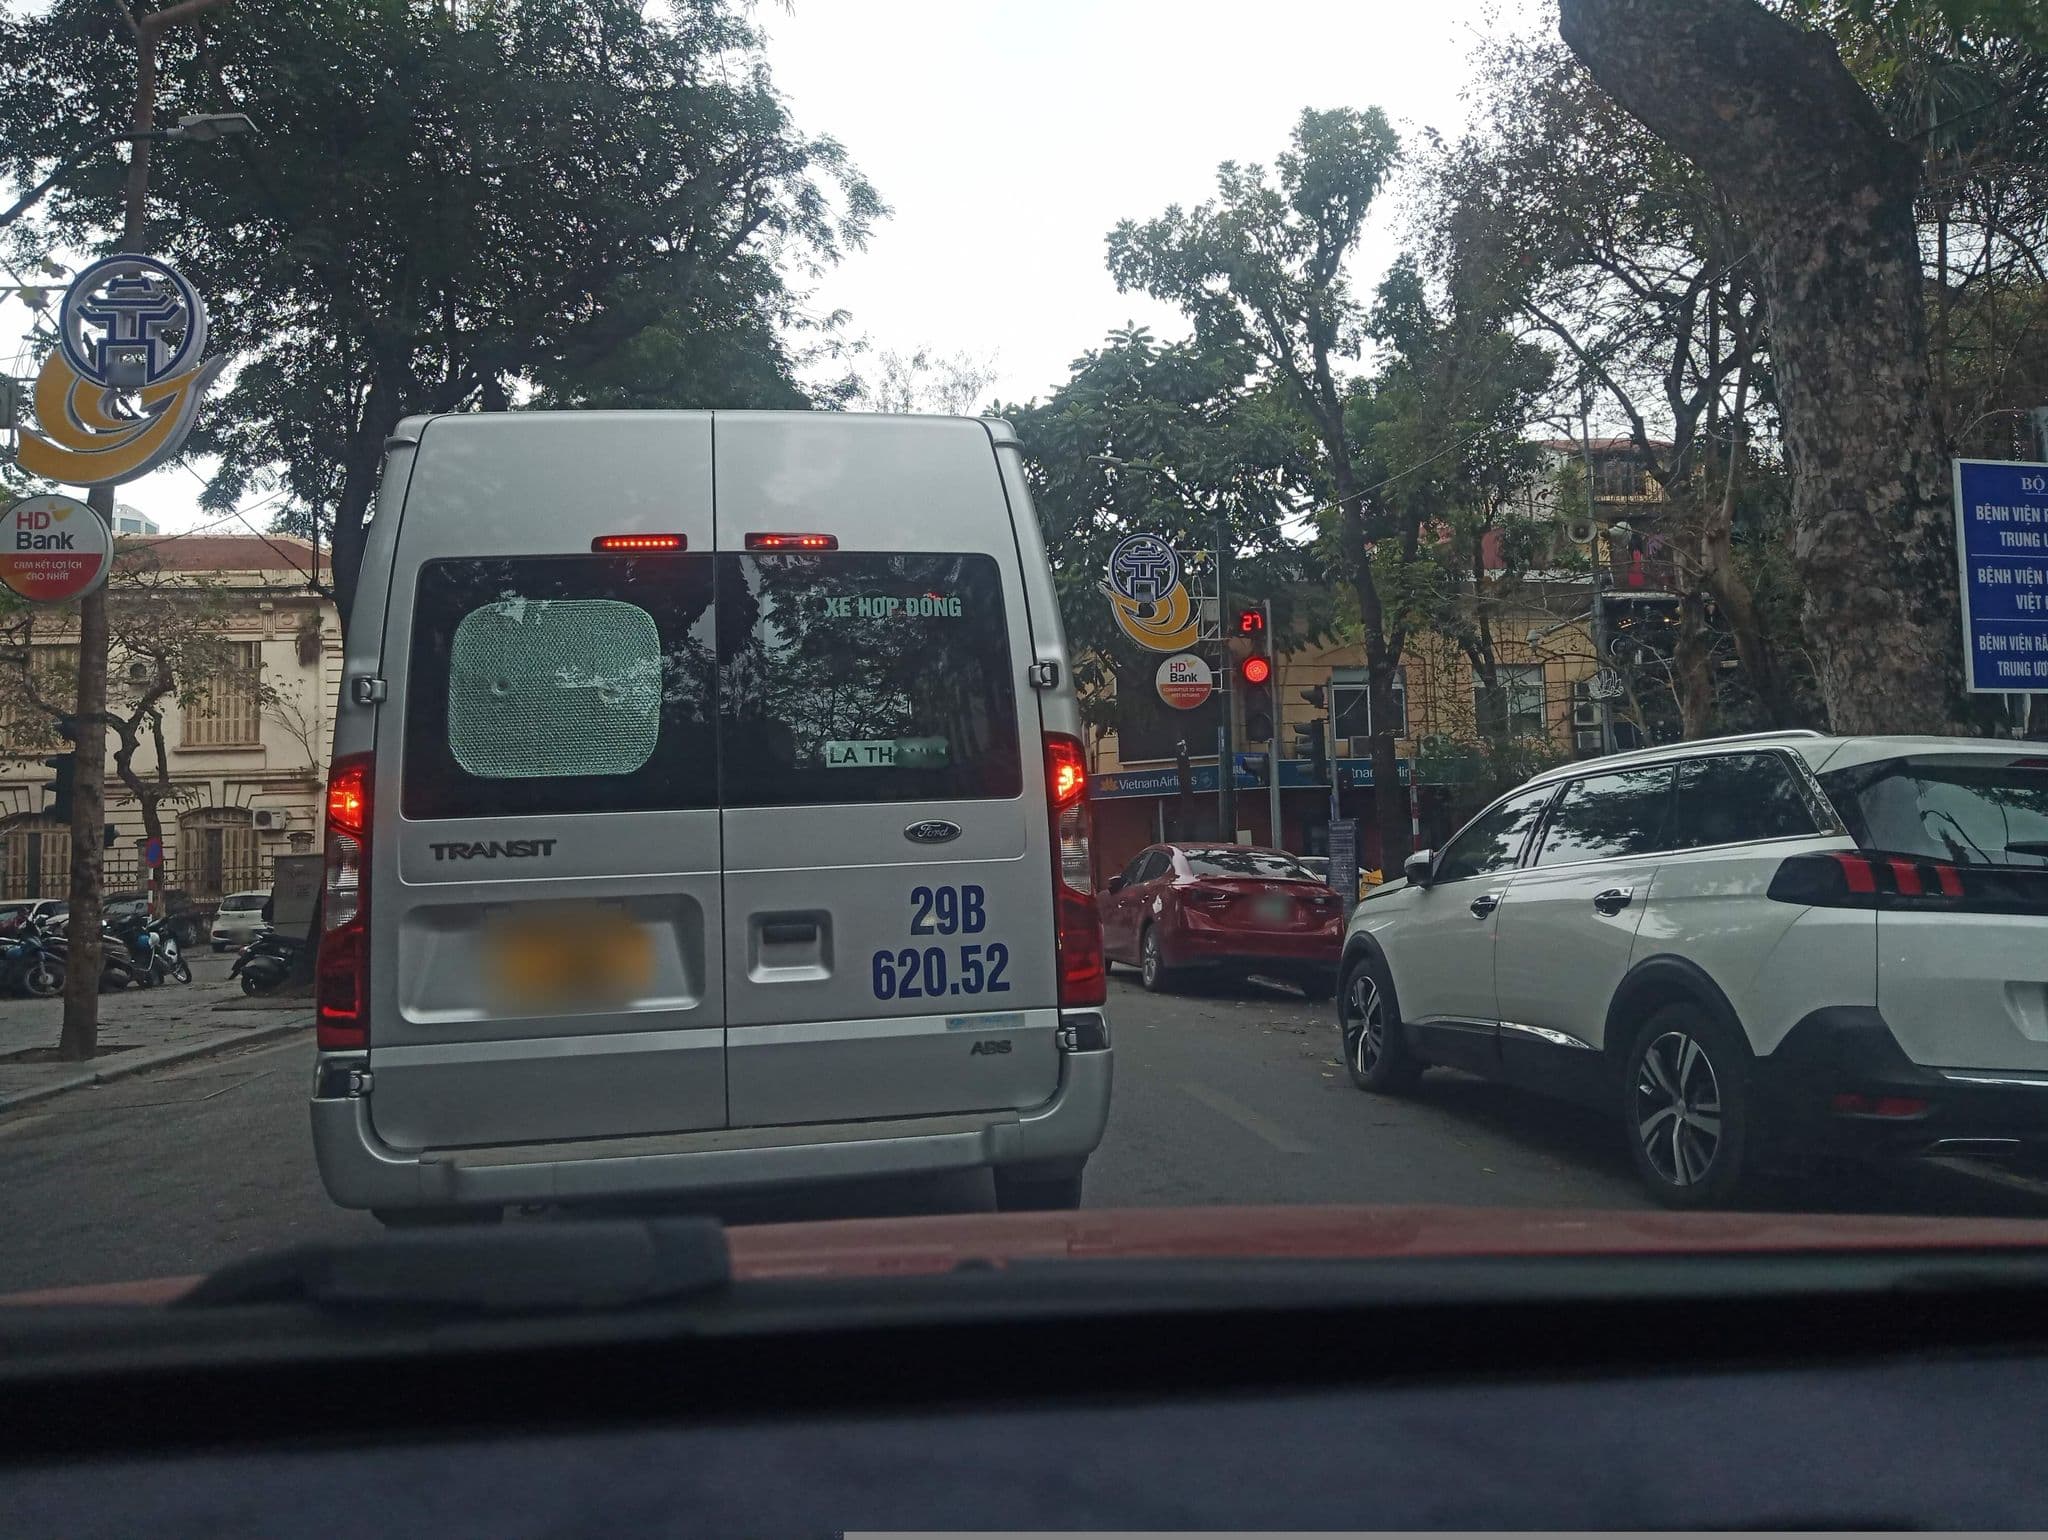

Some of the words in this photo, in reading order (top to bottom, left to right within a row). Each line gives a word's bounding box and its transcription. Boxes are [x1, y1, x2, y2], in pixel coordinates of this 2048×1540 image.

[2021, 474, 2046, 494] BỘ
[16, 511, 51, 530] HD
[1976, 503, 2009, 524] BỆNH
[2012, 504, 2041, 525] VIỆN
[16, 531, 75, 550] Bank
[2000, 532, 2041, 547] TRUNG
[26, 572, 45, 580] CAO
[1978, 565, 2012, 587] BỆNH
[2015, 566, 2043, 588] VIỆN
[825, 597, 851, 618] XE
[858, 595, 900, 619] HỢP
[2016, 592, 2042, 613] VIỆT
[1242, 613, 1263, 631] 27
[1979, 632, 2007, 654] BỆNH
[2009, 632, 2033, 654] VIỆN
[1170, 662, 1187, 672] HD
[1997, 661, 2031, 677] TRUNG
[1170, 672, 1198, 683] Bank
[829, 747, 858, 764] LA
[1119, 777, 1159, 790] Vietnam
[1159, 774, 1198, 787] Airlis
[917, 823, 950, 838] Ford
[429, 839, 557, 861] TRANSIT
[910, 885, 986, 936] 29B
[872, 943, 1010, 1000] 620.52
[970, 1040, 1013, 1056] ABS
